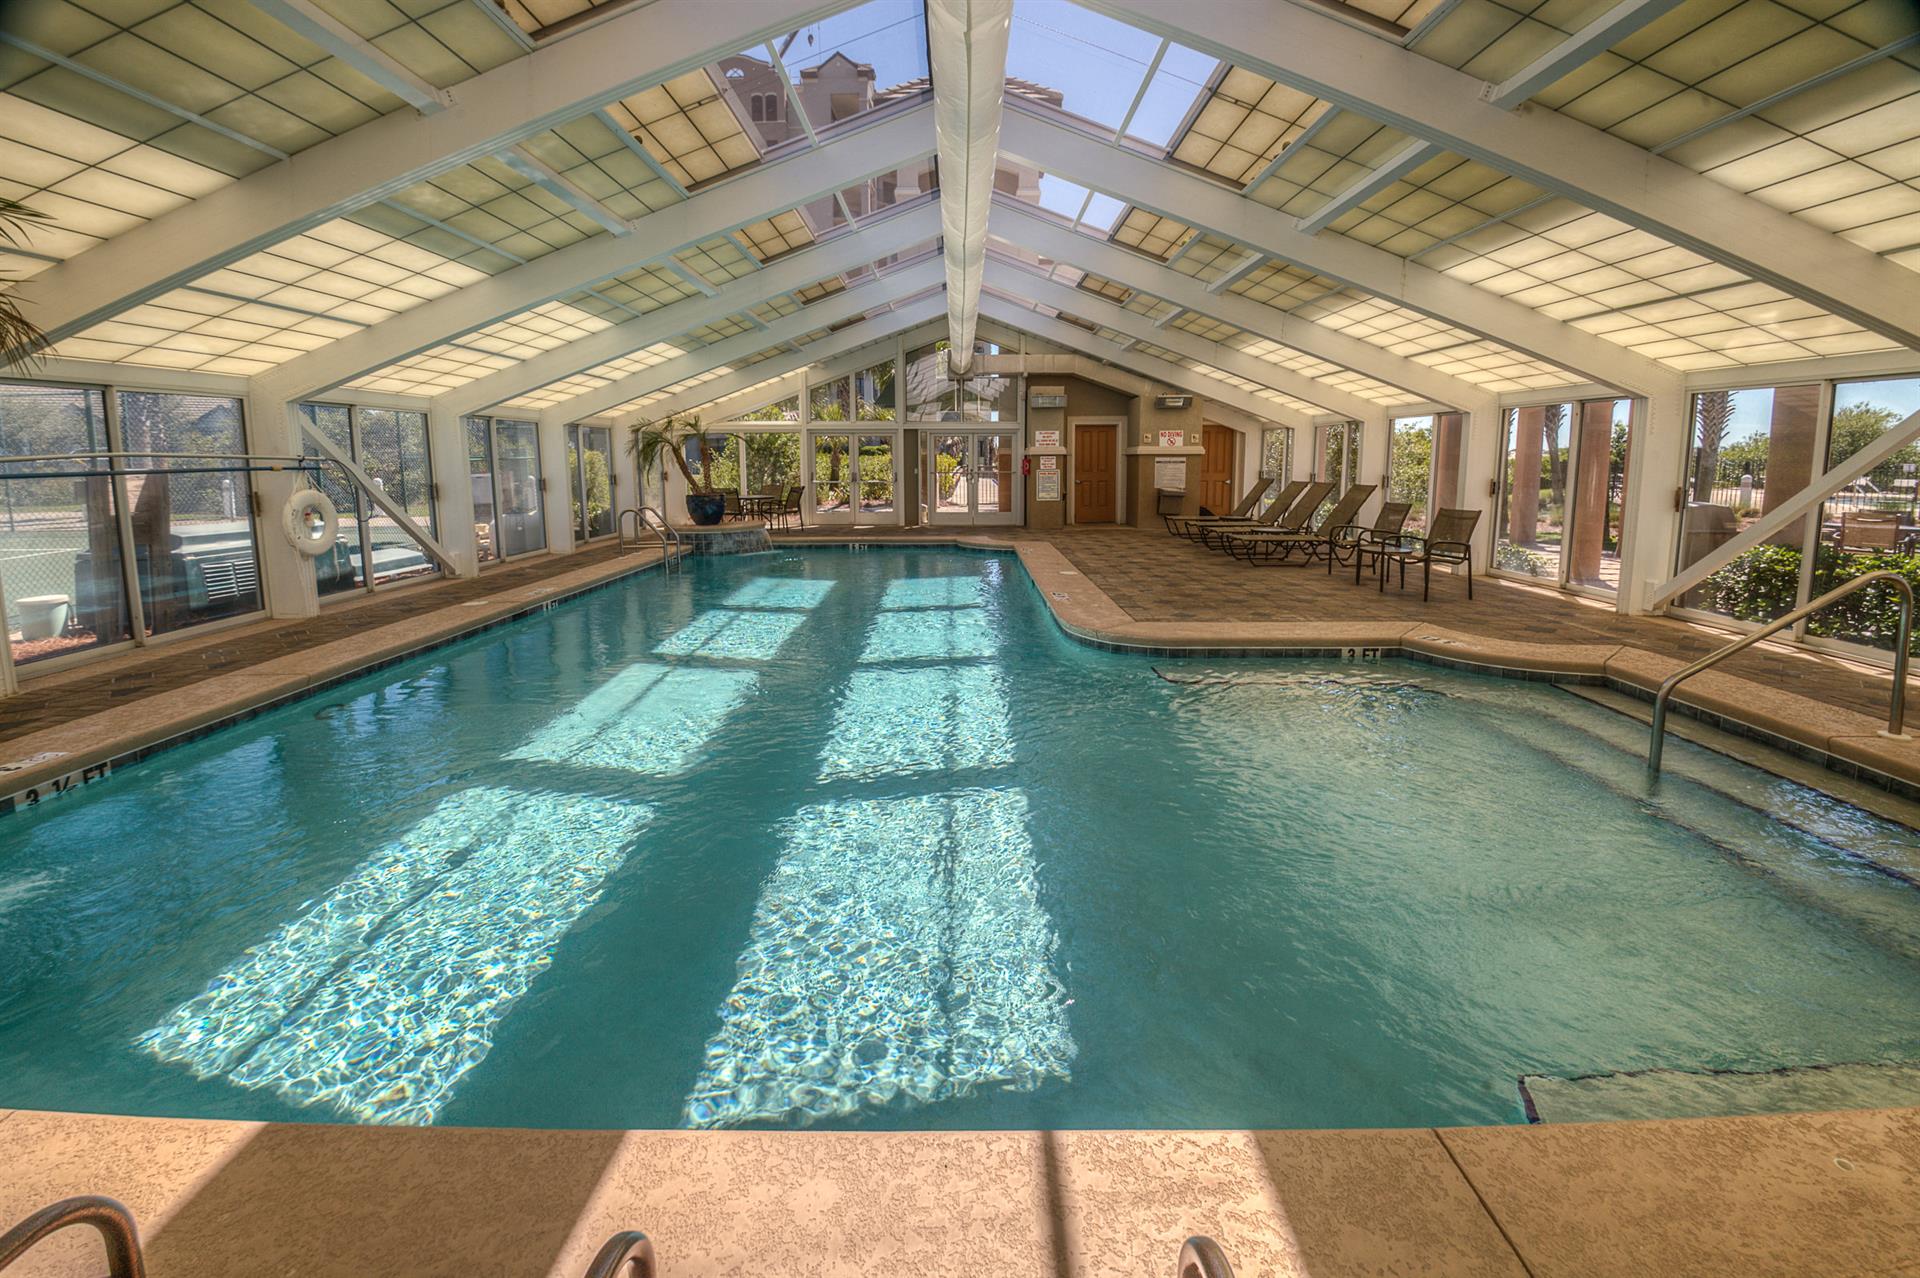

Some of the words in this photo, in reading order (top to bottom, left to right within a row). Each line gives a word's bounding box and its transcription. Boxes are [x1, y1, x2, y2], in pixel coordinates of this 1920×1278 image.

[1347, 648, 1356, 658] 3
[1362, 648, 1380, 658] FT
[25, 788, 41, 807] 3
[82, 761, 109, 785] FT
